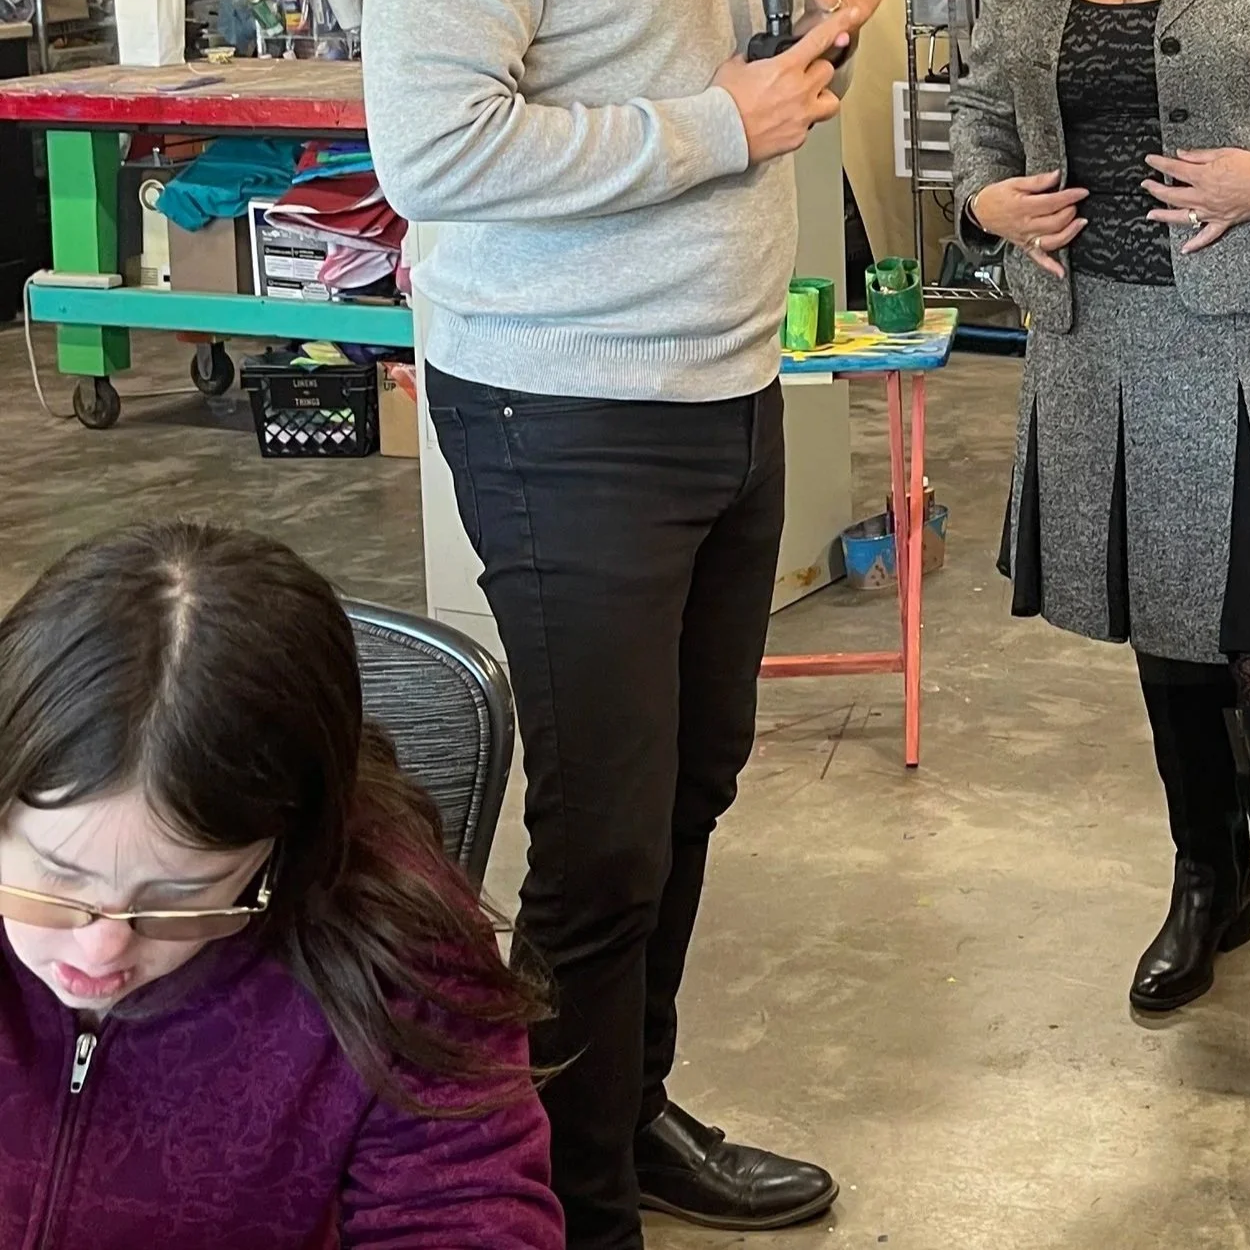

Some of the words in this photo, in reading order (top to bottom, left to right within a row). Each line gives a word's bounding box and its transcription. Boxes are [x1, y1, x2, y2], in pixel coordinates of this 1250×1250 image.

[293, 379, 318, 389] LINENS
[383, 382, 396, 392] UP
[295, 397, 321, 407] THINGS
